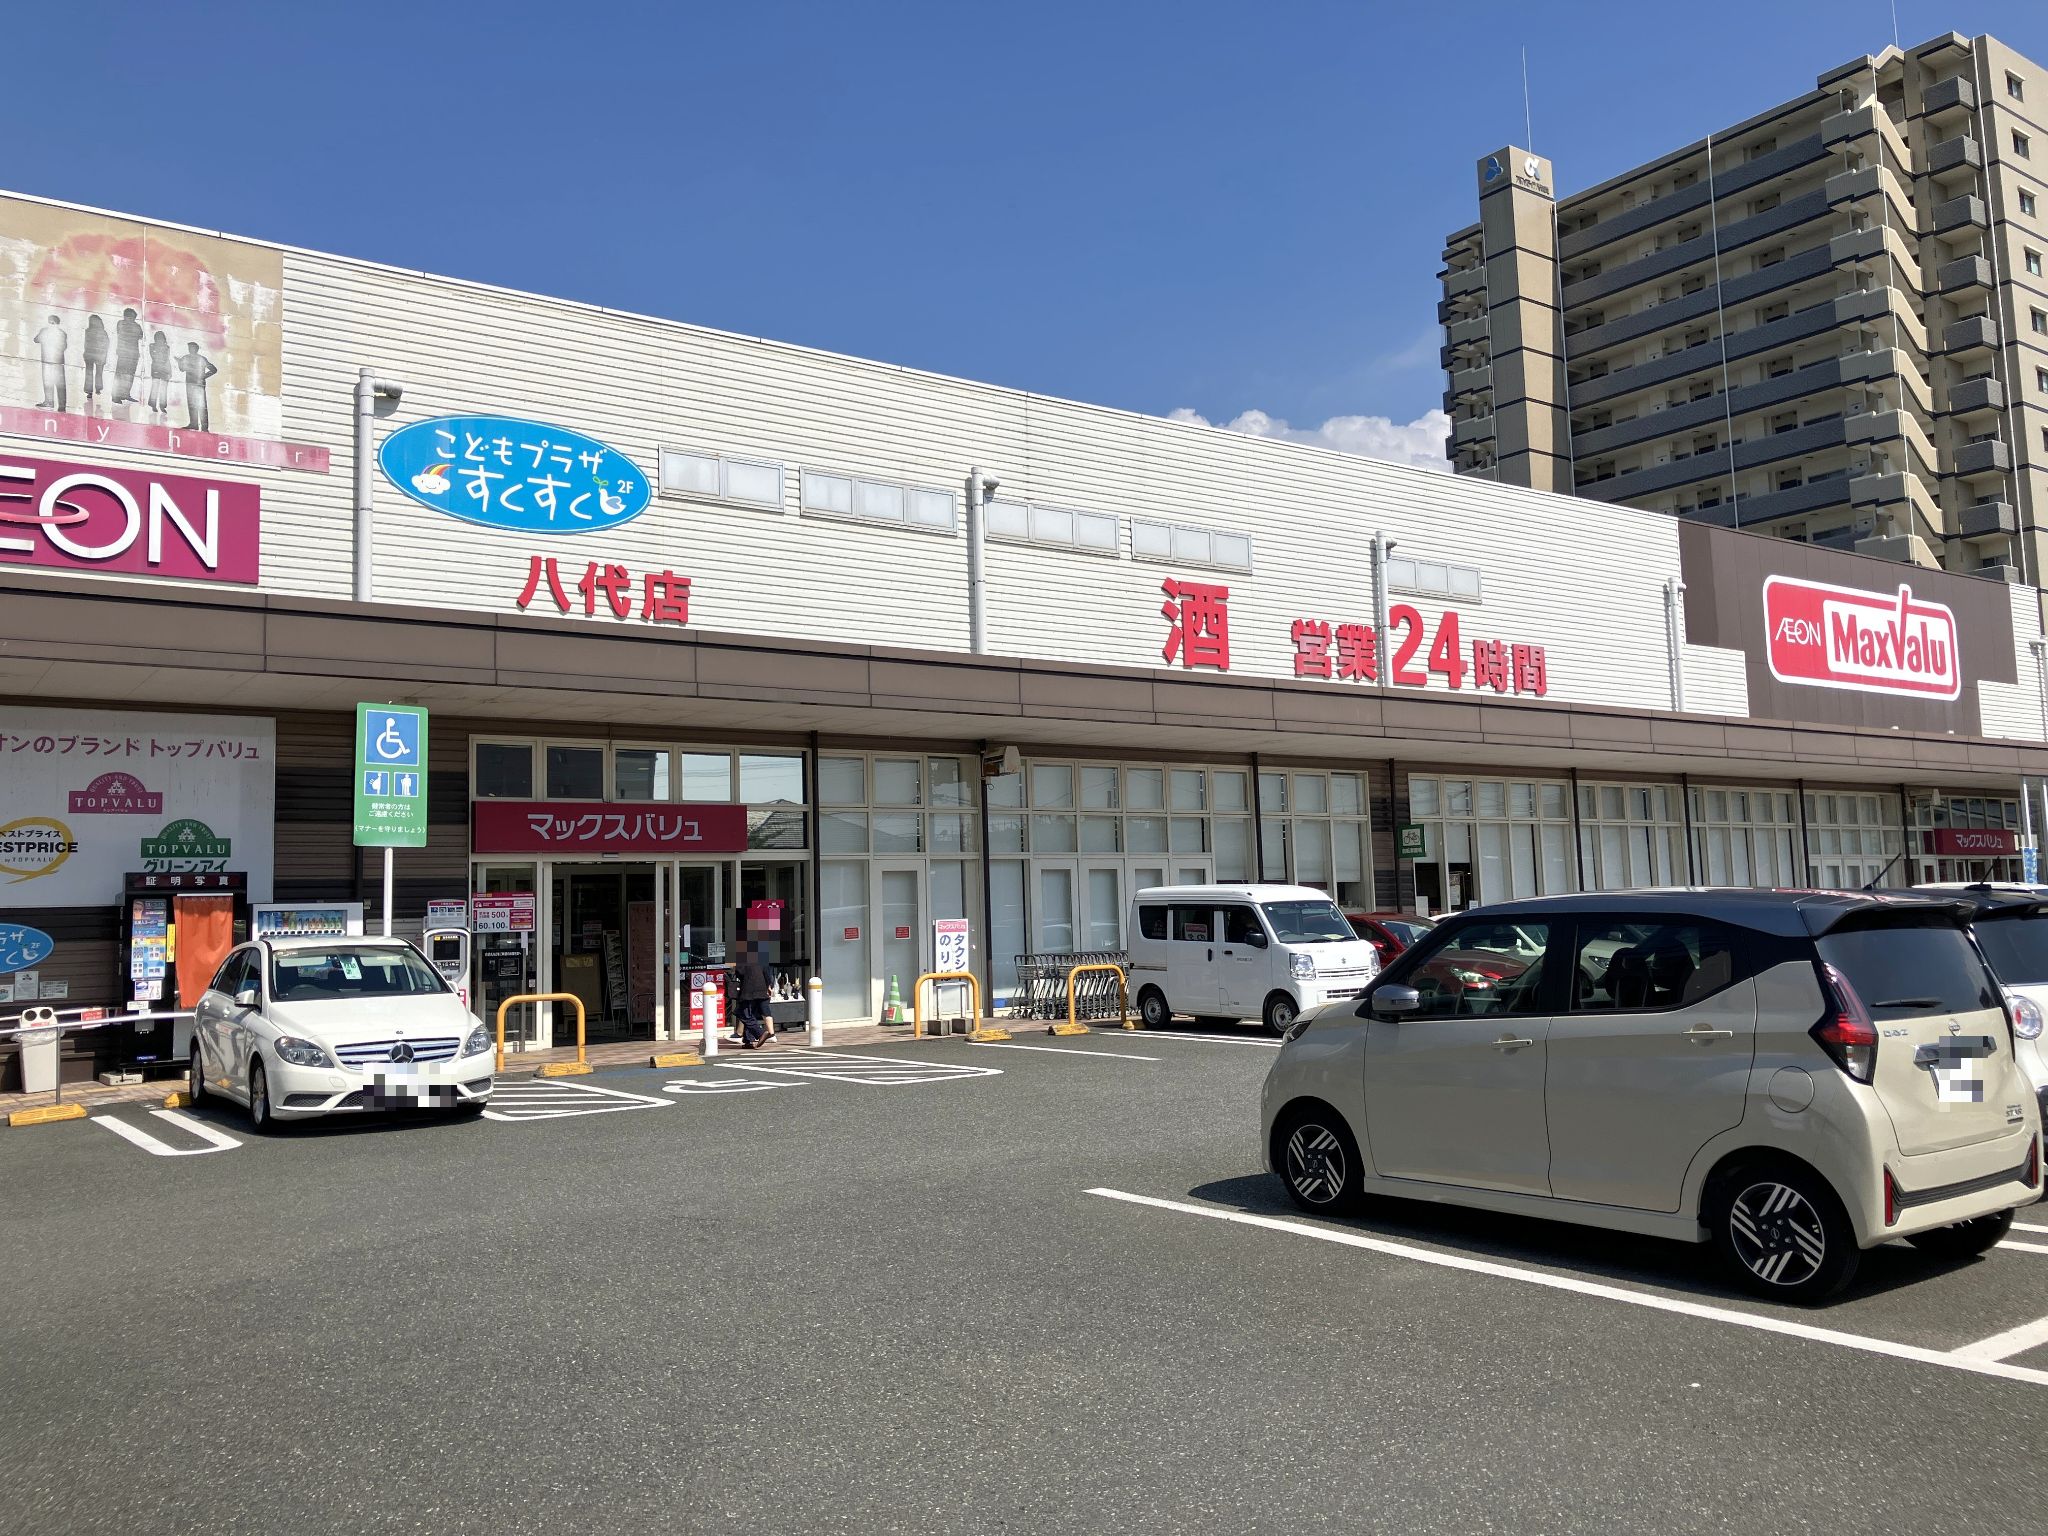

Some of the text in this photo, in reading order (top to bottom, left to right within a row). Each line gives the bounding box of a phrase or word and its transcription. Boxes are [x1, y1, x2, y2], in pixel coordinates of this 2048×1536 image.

[434, 429, 607, 475] こどもプラザ
[457, 465, 593, 521] すくすく
[616, 479, 634, 494] 2F
[516, 556, 691, 624] 八代店
[1161, 577, 1230, 671] 酒
[1831, 590, 1947, 677] MaxValu
[1290, 604, 1548, 697] 営業24時間
[150, 738, 260, 760] トップバリュ
[75, 797, 158, 809] TOPVALU
[527, 813, 703, 841] マックスバリュ
[147, 844, 226, 855] TOPVALU
[1955, 833, 2004, 850] マックスバリュ
[143, 858, 228, 873] グリーンアイ
[145, 875, 229, 886] 証明写真
